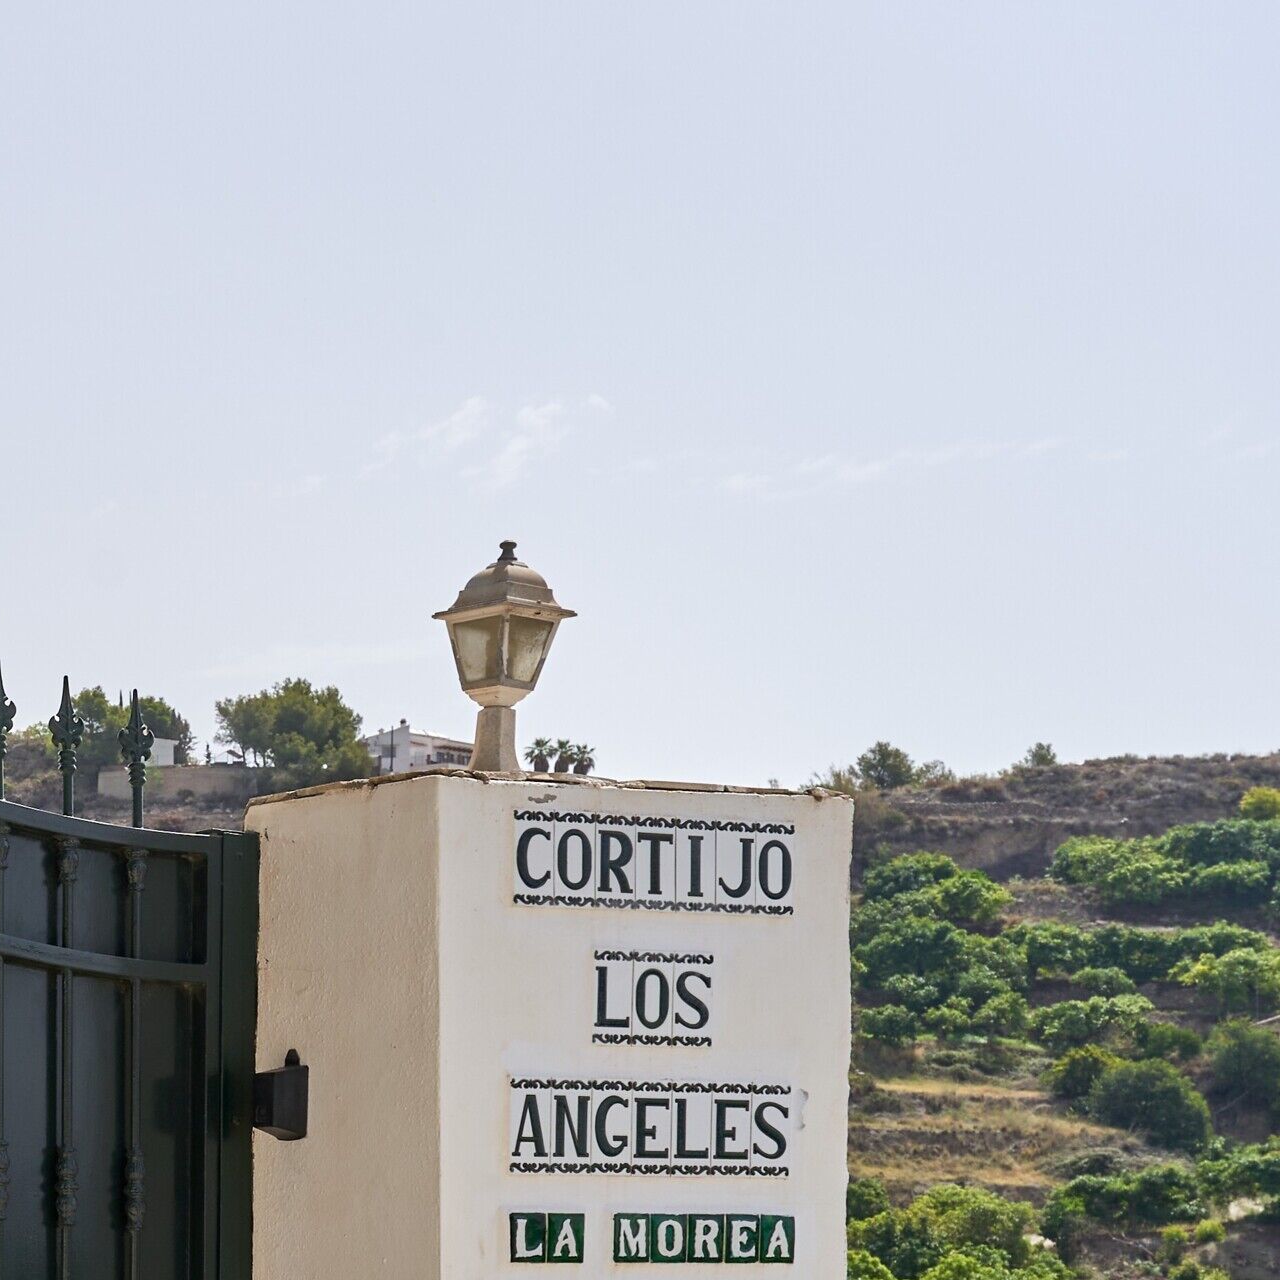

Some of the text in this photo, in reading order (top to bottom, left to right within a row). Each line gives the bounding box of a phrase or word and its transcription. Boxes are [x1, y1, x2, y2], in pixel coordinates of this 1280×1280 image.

[515, 826, 793, 901] CORTIJO
[593, 965, 713, 1031] LOS
[511, 1094, 790, 1161] ANGELES
[514, 1217, 791, 1259] LA MOREA
